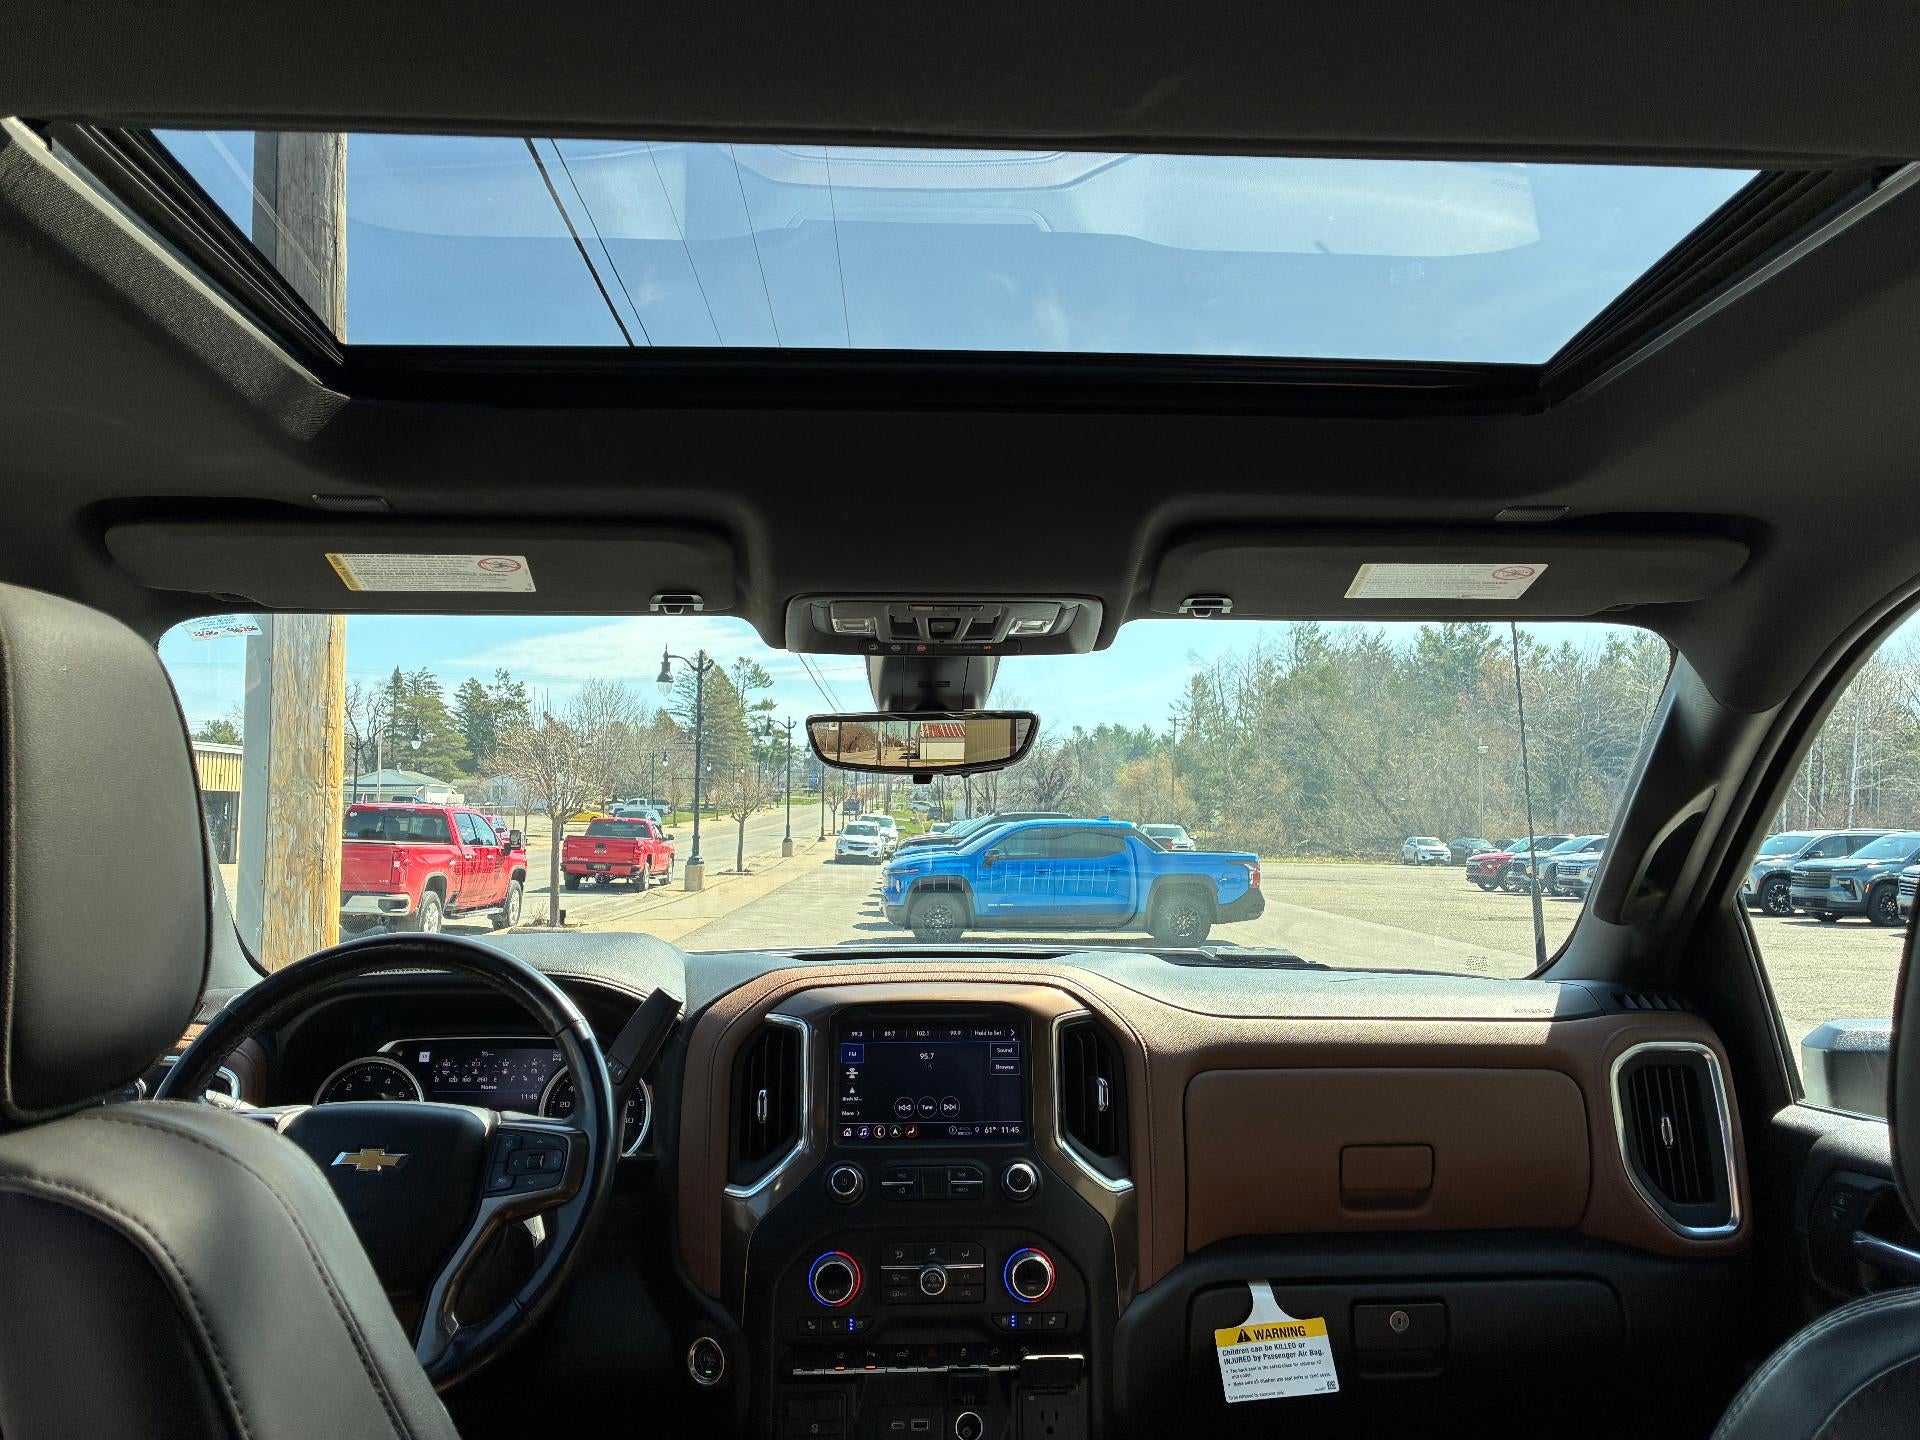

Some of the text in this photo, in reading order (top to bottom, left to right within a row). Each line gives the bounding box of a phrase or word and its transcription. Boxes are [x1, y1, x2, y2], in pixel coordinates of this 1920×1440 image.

[1253, 1326, 1306, 1340] WARNING
[1224, 1356, 1251, 1365] INJURED
[1263, 1352, 1296, 1360] Passenger
